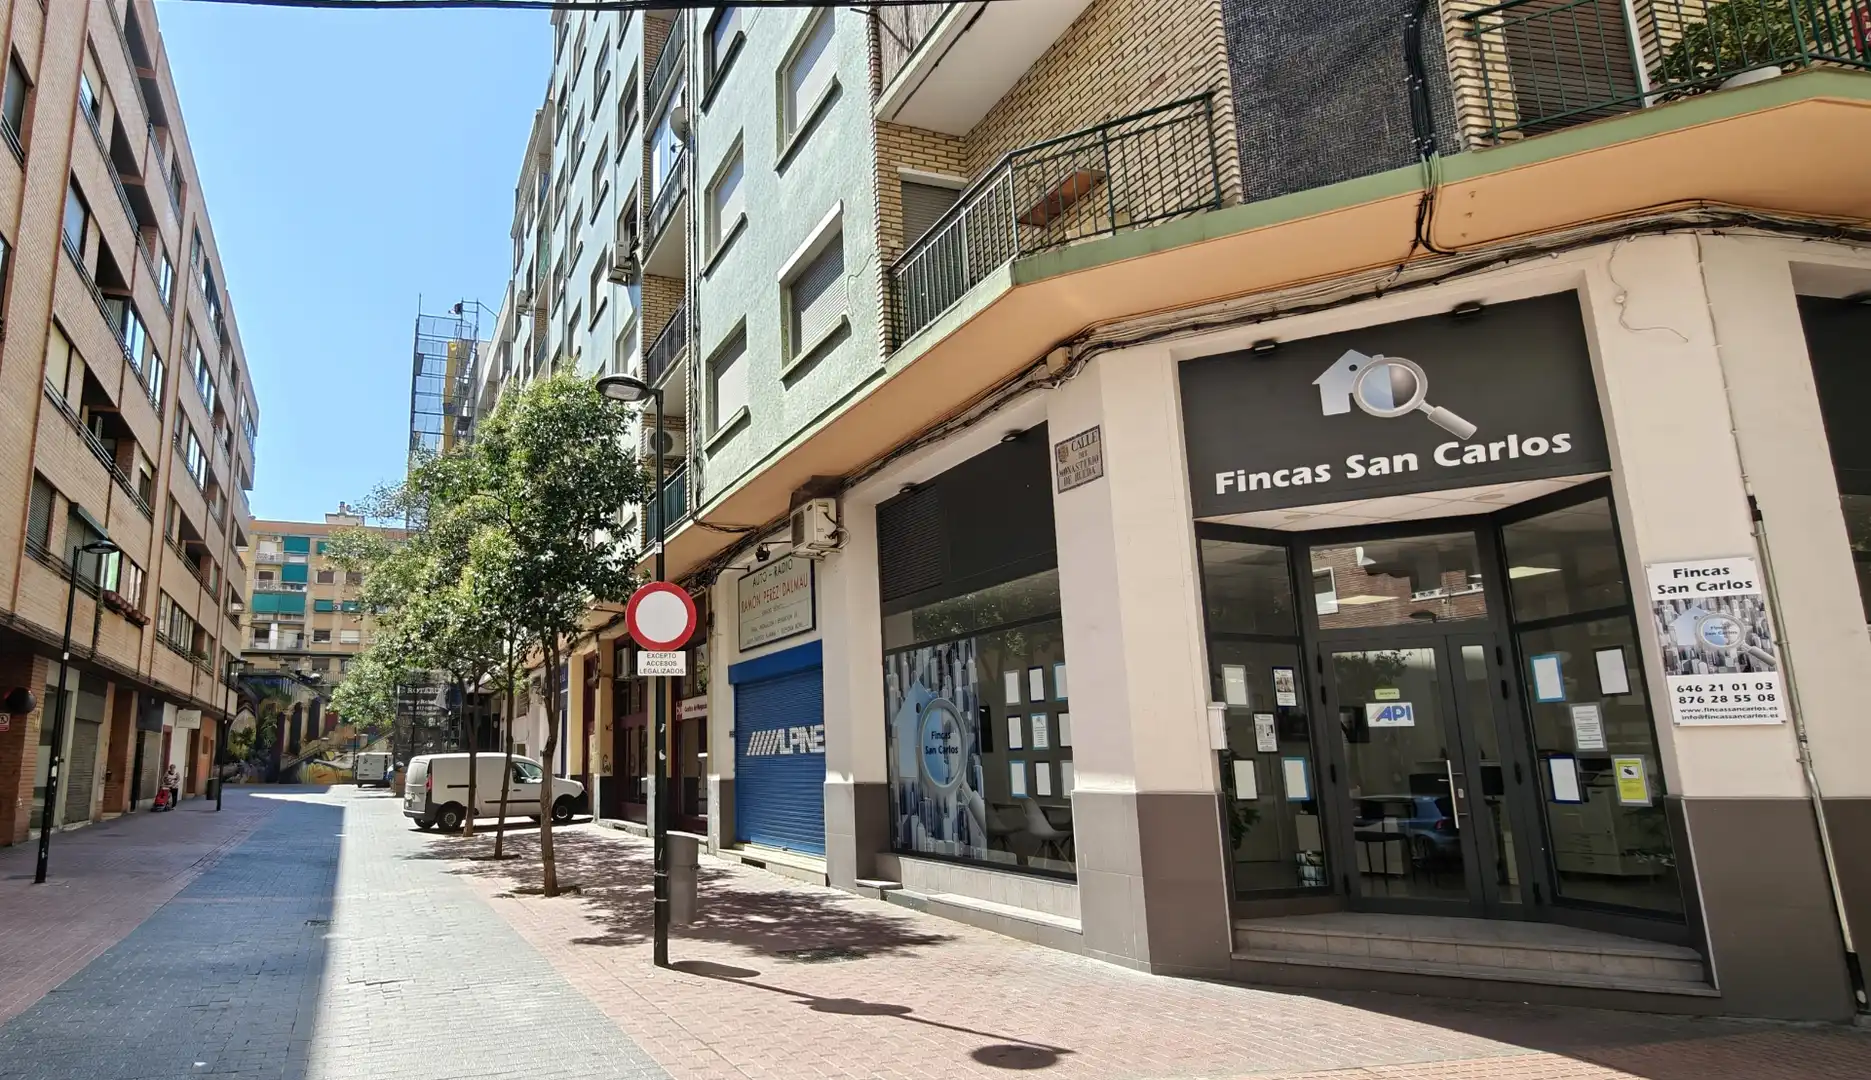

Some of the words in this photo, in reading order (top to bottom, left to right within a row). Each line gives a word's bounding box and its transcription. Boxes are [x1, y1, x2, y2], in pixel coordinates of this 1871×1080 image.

[1072, 430, 1097, 451] CALLE
[1216, 463, 1332, 495] Fincas
[1346, 452, 1419, 480] San
[1433, 433, 1572, 467] Carlos
[1064, 475, 1071, 486] DE
[1673, 567, 1730, 579] Fincas
[1657, 584, 1689, 595] San
[1696, 580, 1753, 592] Carlos
[1677, 684, 1703, 693] 646
[1708, 683, 1724, 692] 21
[1731, 683, 1747, 691] 01
[1755, 682, 1773, 690] 03
[1678, 696, 1705, 704] 876
[1710, 695, 1728, 703] 28
[1734, 694, 1751, 703] 55
[1757, 694, 1775, 702] 08
[1375, 705, 1412, 722] API
[746, 724, 825, 756] ALPINE
[931, 730, 951, 740] Fincas
[925, 745, 937, 755] San
[938, 745, 959, 755] Carlos
